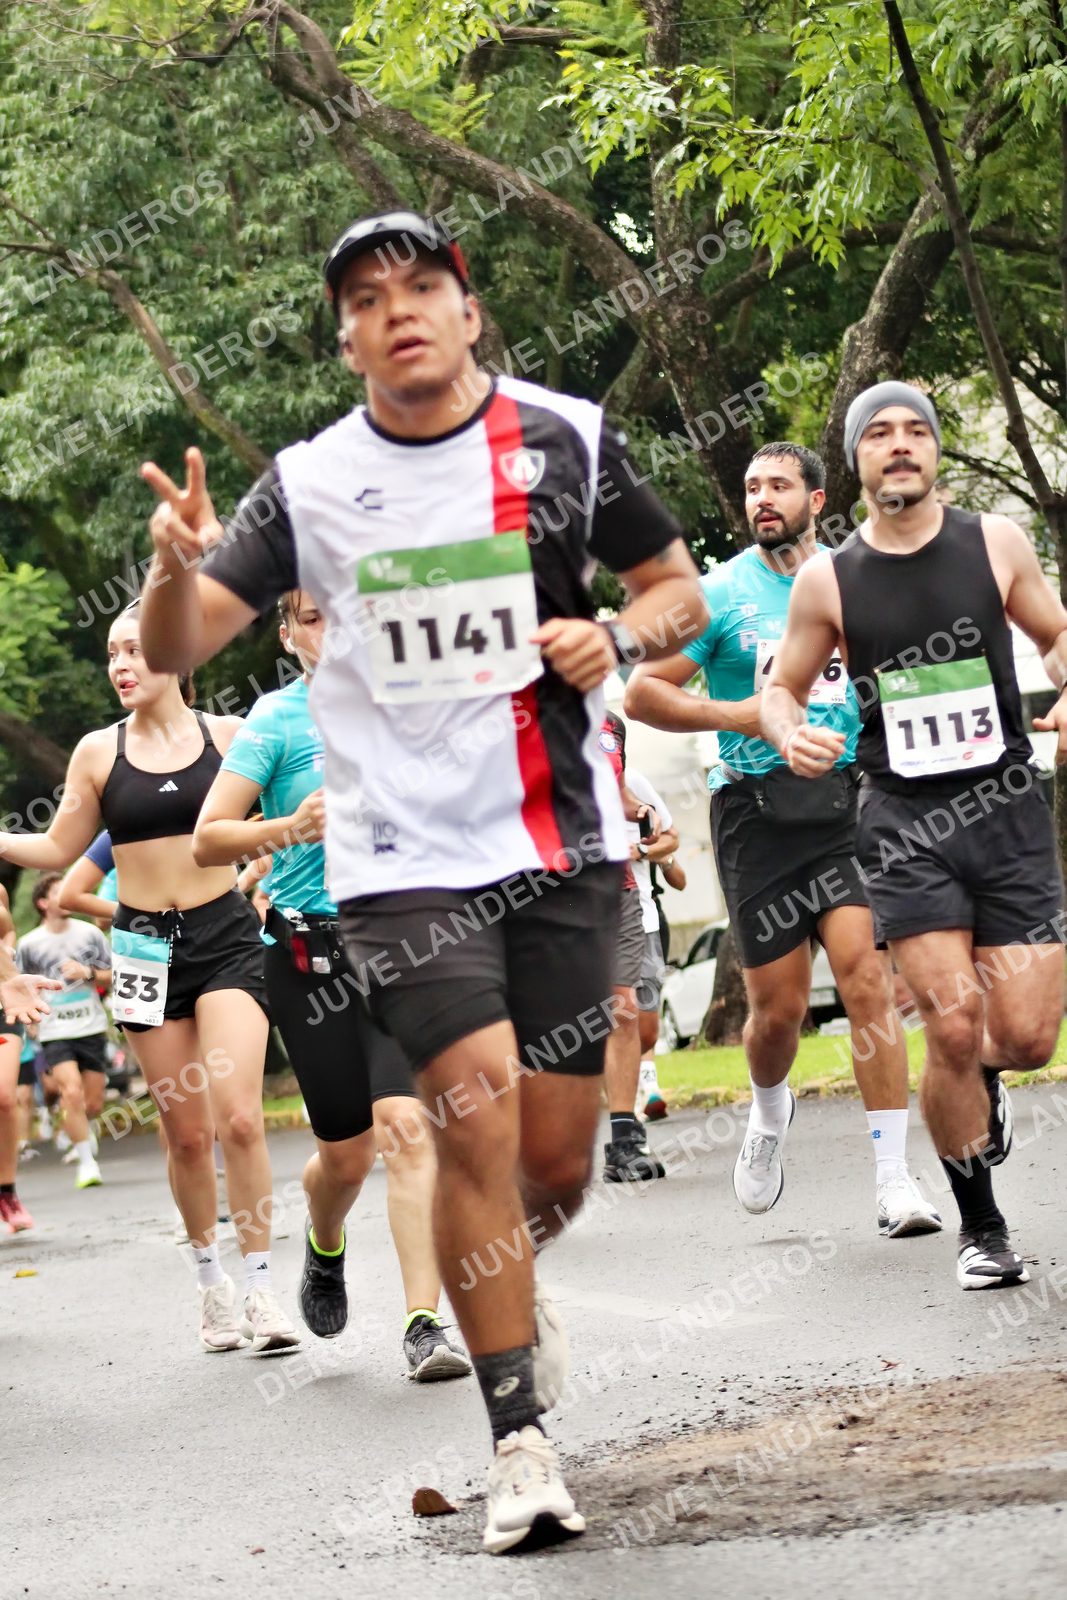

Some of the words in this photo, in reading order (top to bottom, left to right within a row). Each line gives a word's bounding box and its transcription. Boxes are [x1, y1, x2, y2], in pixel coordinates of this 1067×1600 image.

[381, 607, 517, 664] 1141
[897, 706, 993, 750] 1113
[114, 971, 159, 1003] 33
